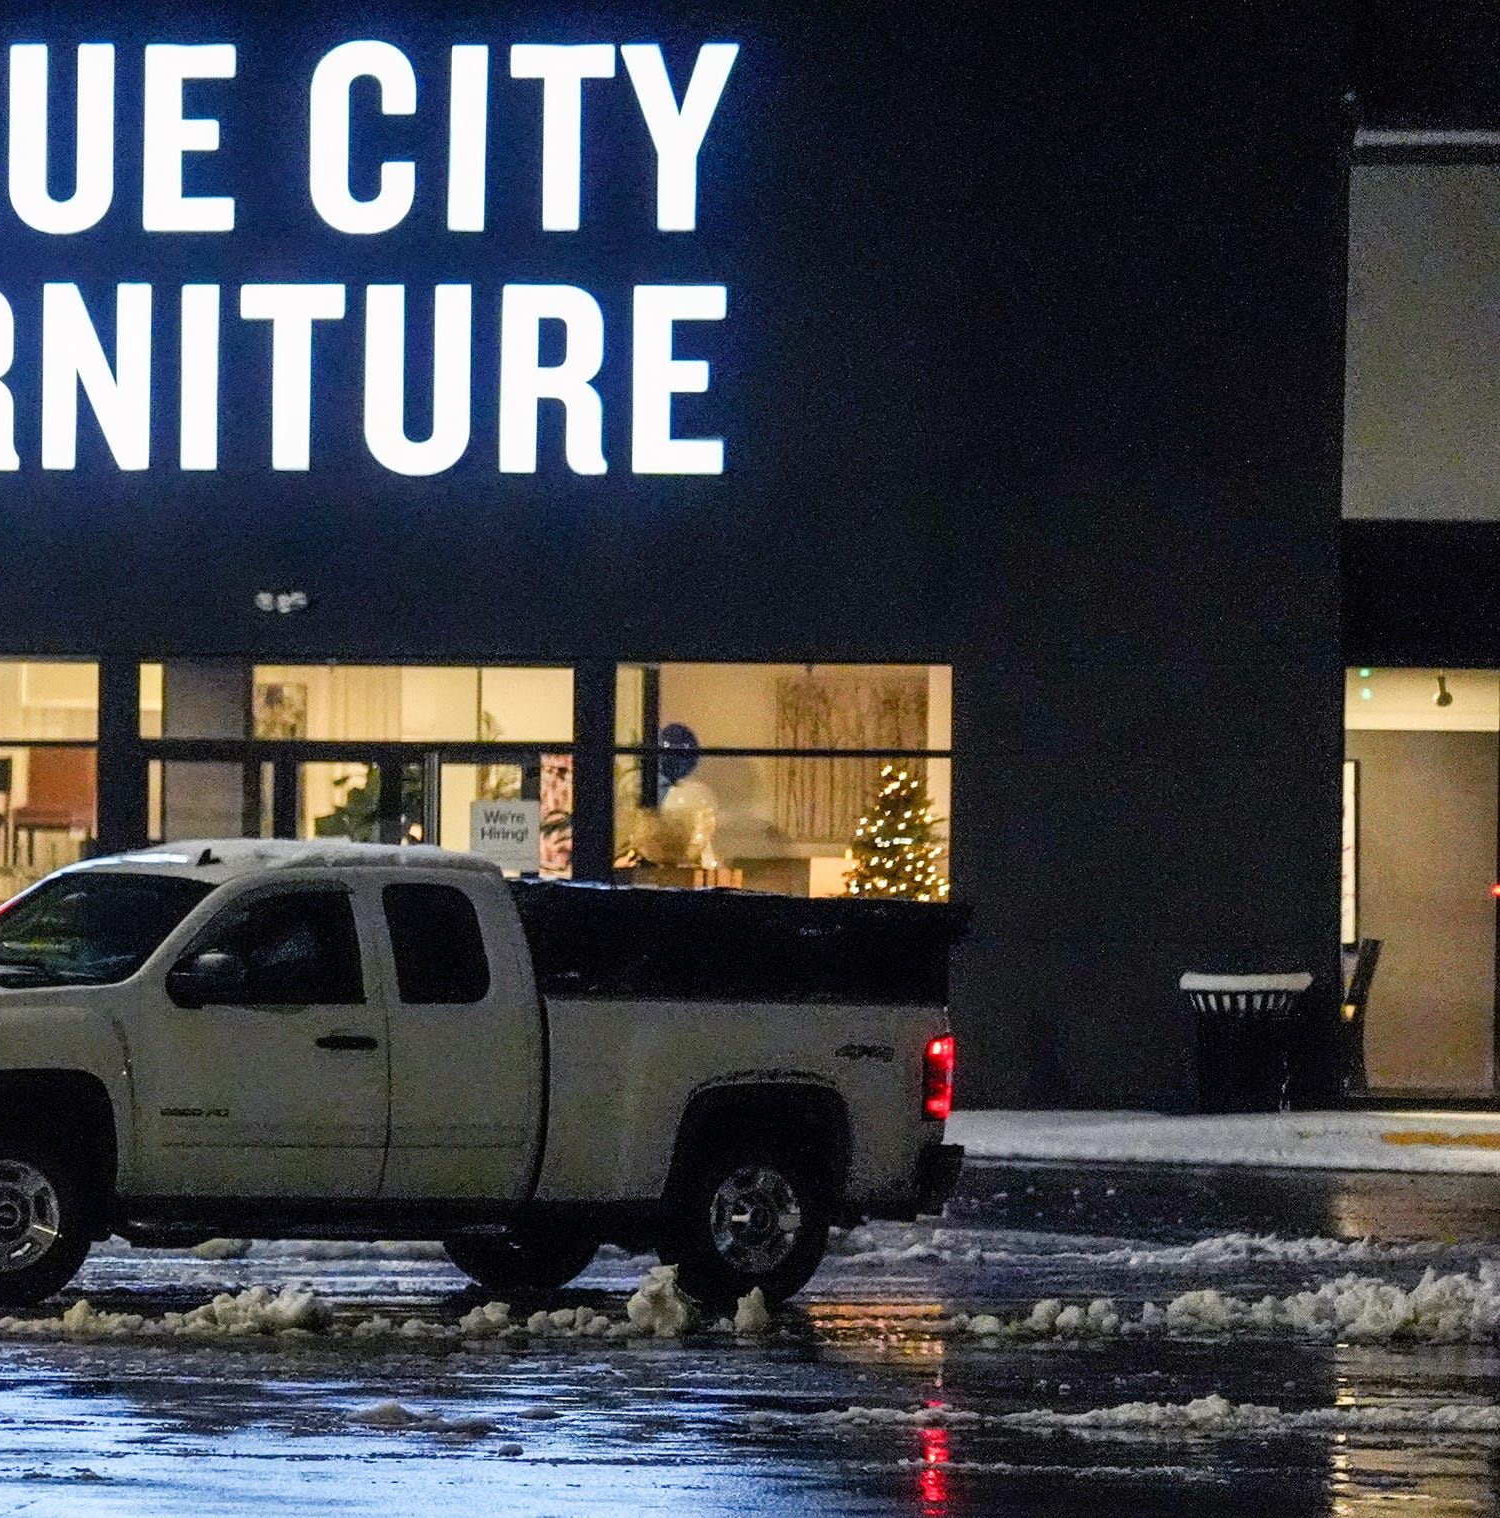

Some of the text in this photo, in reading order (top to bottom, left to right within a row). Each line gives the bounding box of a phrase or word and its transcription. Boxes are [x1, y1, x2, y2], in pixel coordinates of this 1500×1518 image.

[309, 40, 740, 235] CITY
[483, 810, 526, 824] We're
[480, 827, 529, 844] Hiring!
